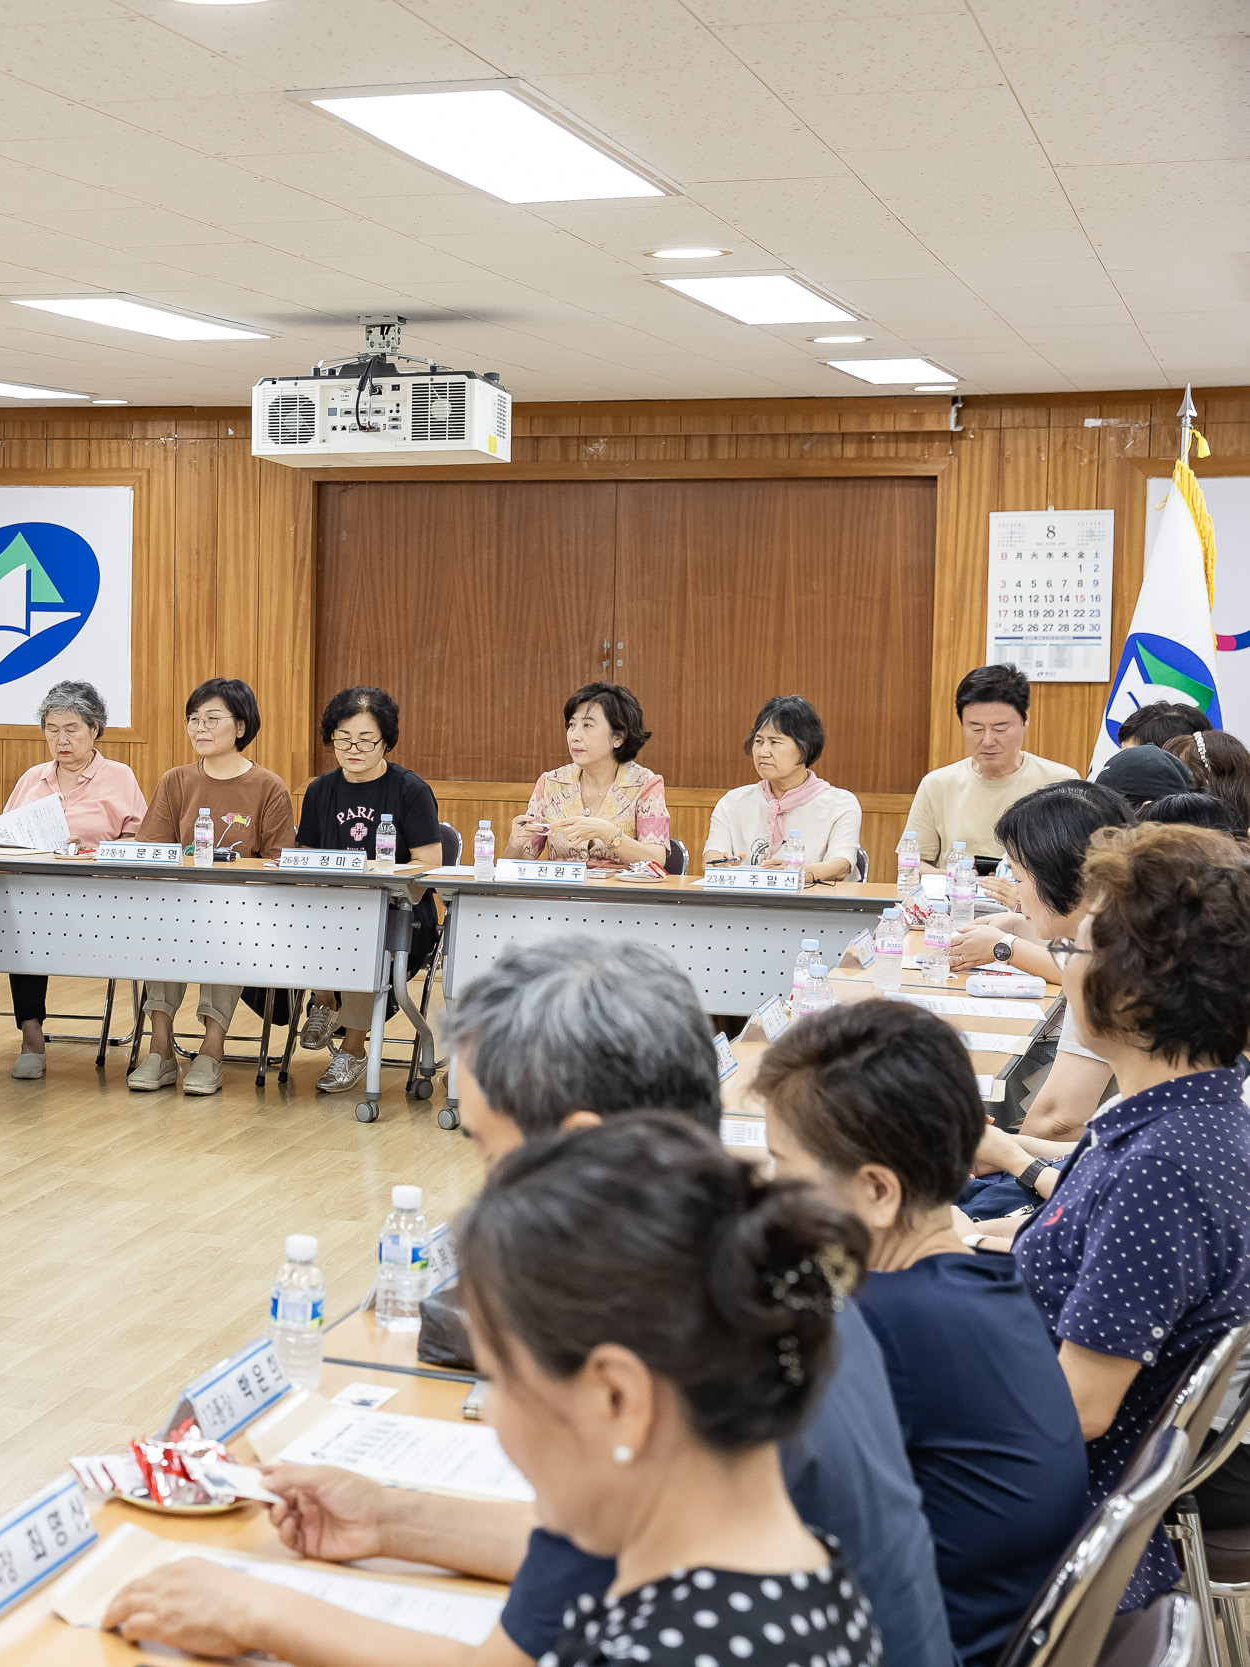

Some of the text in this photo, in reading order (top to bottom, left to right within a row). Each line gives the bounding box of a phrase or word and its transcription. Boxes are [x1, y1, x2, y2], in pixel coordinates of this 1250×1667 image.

[1046, 525, 1056, 539] 8
[1000, 552, 1008, 560] 日
[1077, 550, 1085, 559] 金
[1079, 564, 1100, 573] 1 2
[1000, 580, 1006, 589] 3
[1031, 580, 1037, 588] 5
[1046, 580, 1052, 588] 6
[1062, 579, 1067, 588] 7
[1077, 579, 1083, 588] 8
[1092, 579, 1099, 588] 9
[998, 595, 1009, 604] 10
[1013, 595, 1023, 603] 11
[1029, 594, 1040, 603] 12
[1044, 594, 1055, 603] 13
[1075, 594, 1086, 603] 15
[1090, 594, 1102, 603] 16
[998, 609, 1101, 618] 17 18 19 20 21 22 23
[1012, 624, 1024, 632] 25
[1027, 624, 1039, 632] 26
[1042, 624, 1054, 632] 27
[1058, 623, 1070, 632] 28
[1073, 623, 1085, 632] 29
[1088, 623, 1101, 632] 30
[100, 848, 126, 858] 27통장
[282, 856, 309, 866] 26통장
[707, 874, 736, 885] 23통장
